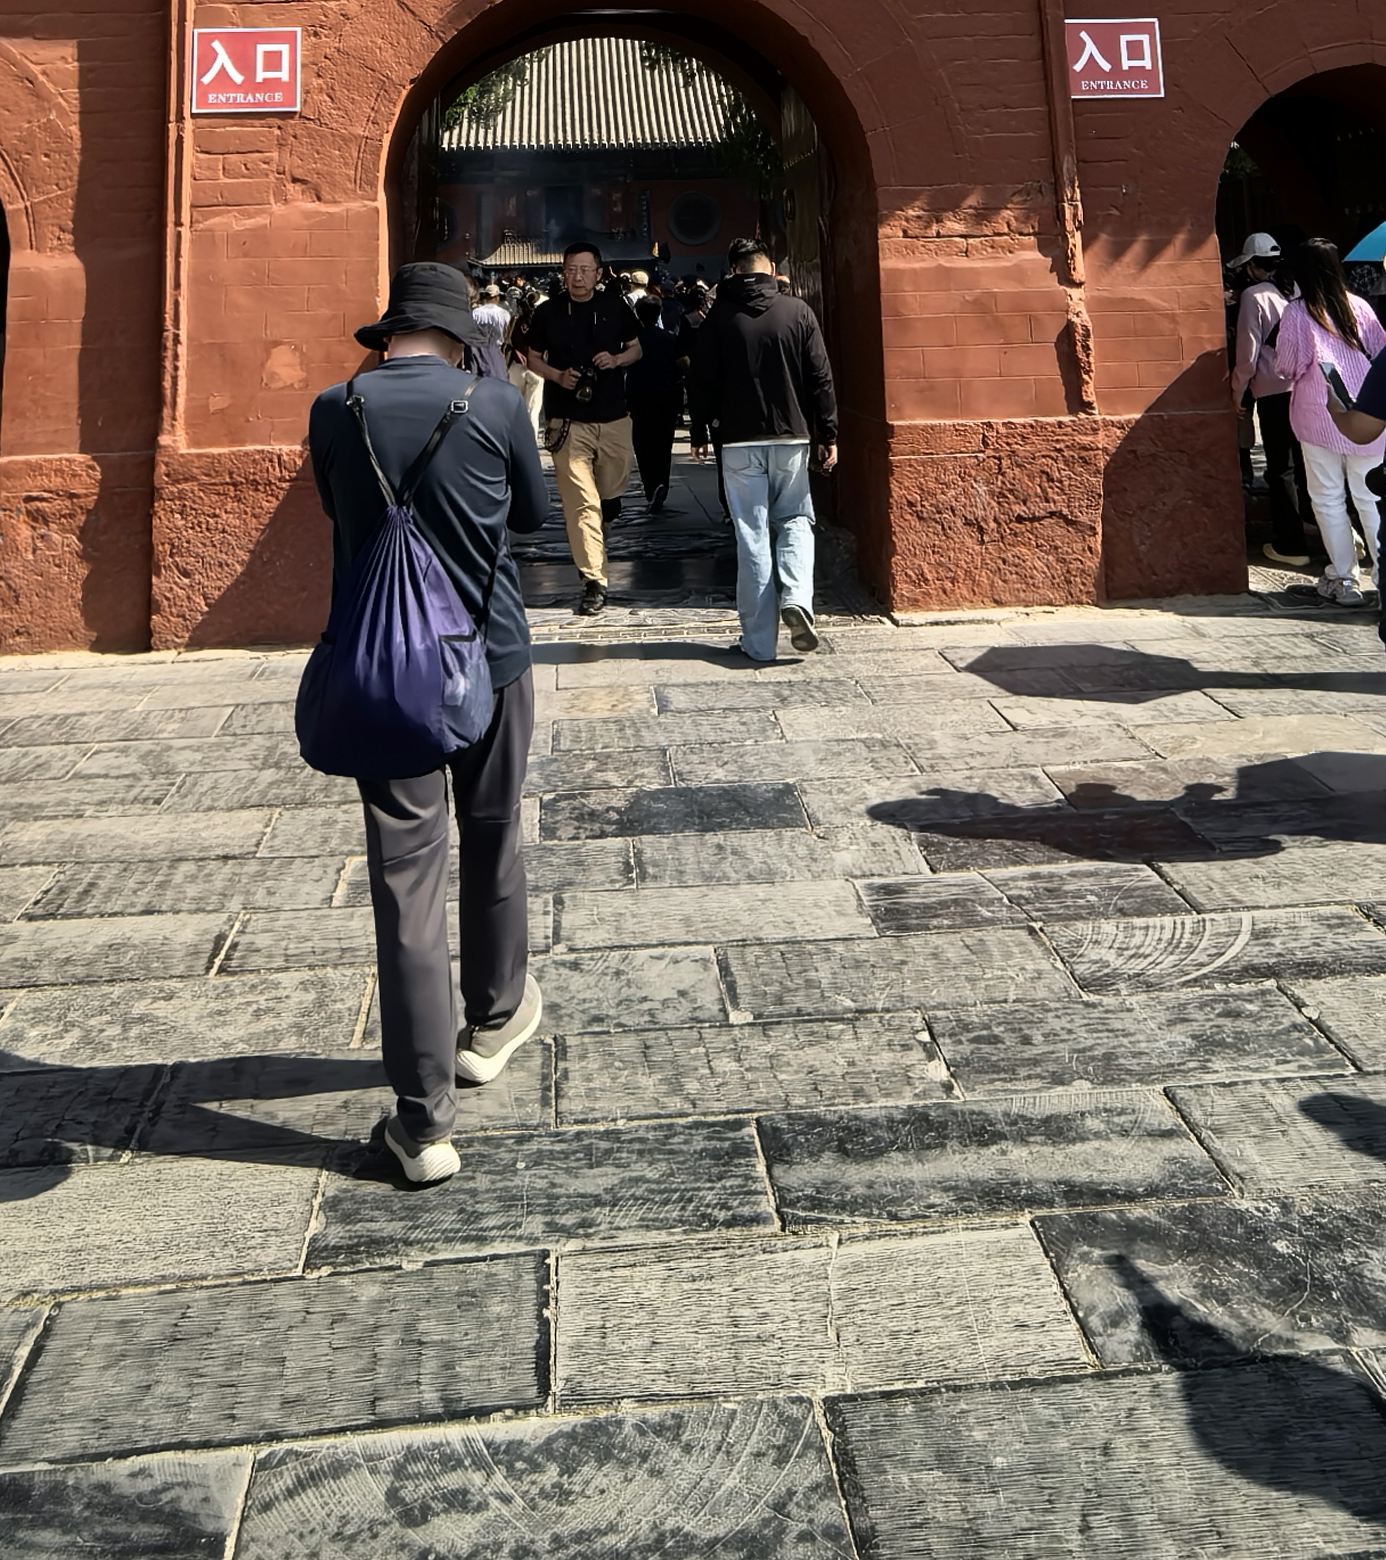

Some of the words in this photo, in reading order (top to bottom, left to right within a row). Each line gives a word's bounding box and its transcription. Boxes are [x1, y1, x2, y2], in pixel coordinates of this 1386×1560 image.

[200, 39, 290, 86] 入口
[1072, 30, 1153, 73] 入口
[207, 92, 284, 104] ENTRANCE
[1081, 79, 1149, 91] ENTRANCE
